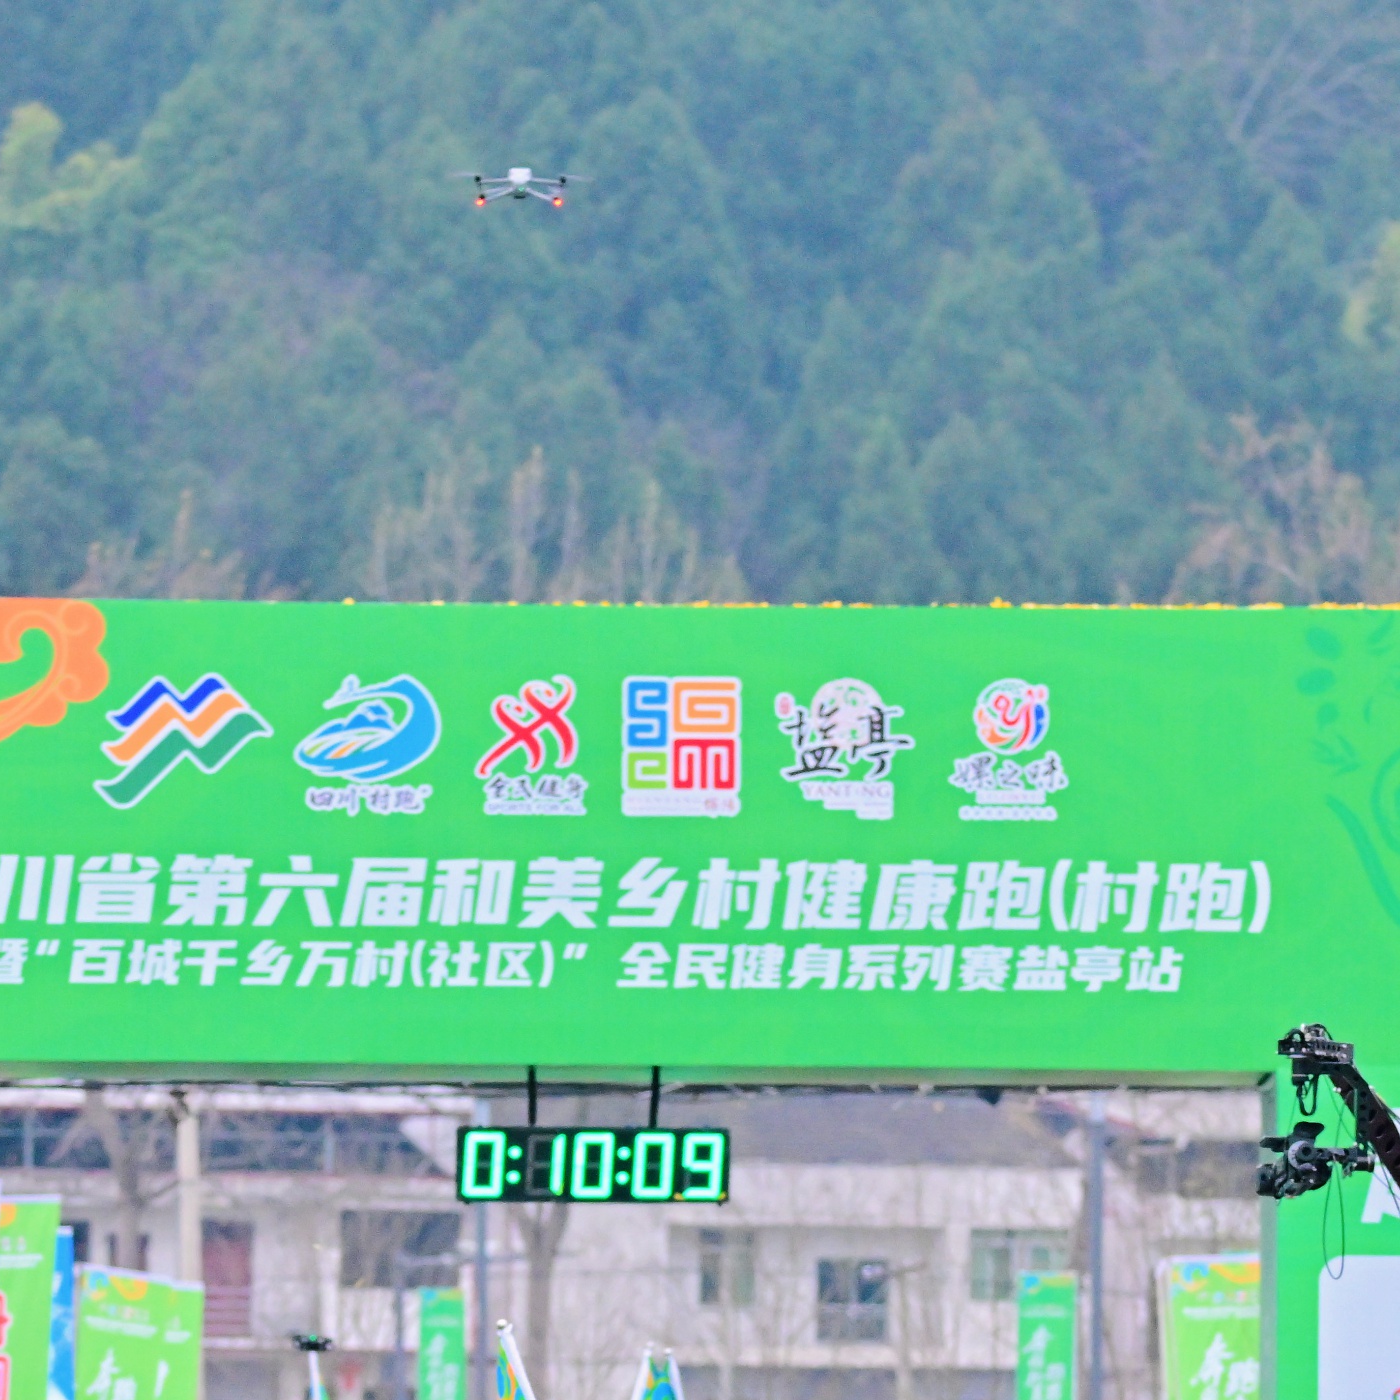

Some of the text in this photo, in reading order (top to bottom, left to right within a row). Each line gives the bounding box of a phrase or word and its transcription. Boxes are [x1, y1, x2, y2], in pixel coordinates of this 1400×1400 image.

[616, 940, 1183, 993] 全民健身系列赛盐亭站
